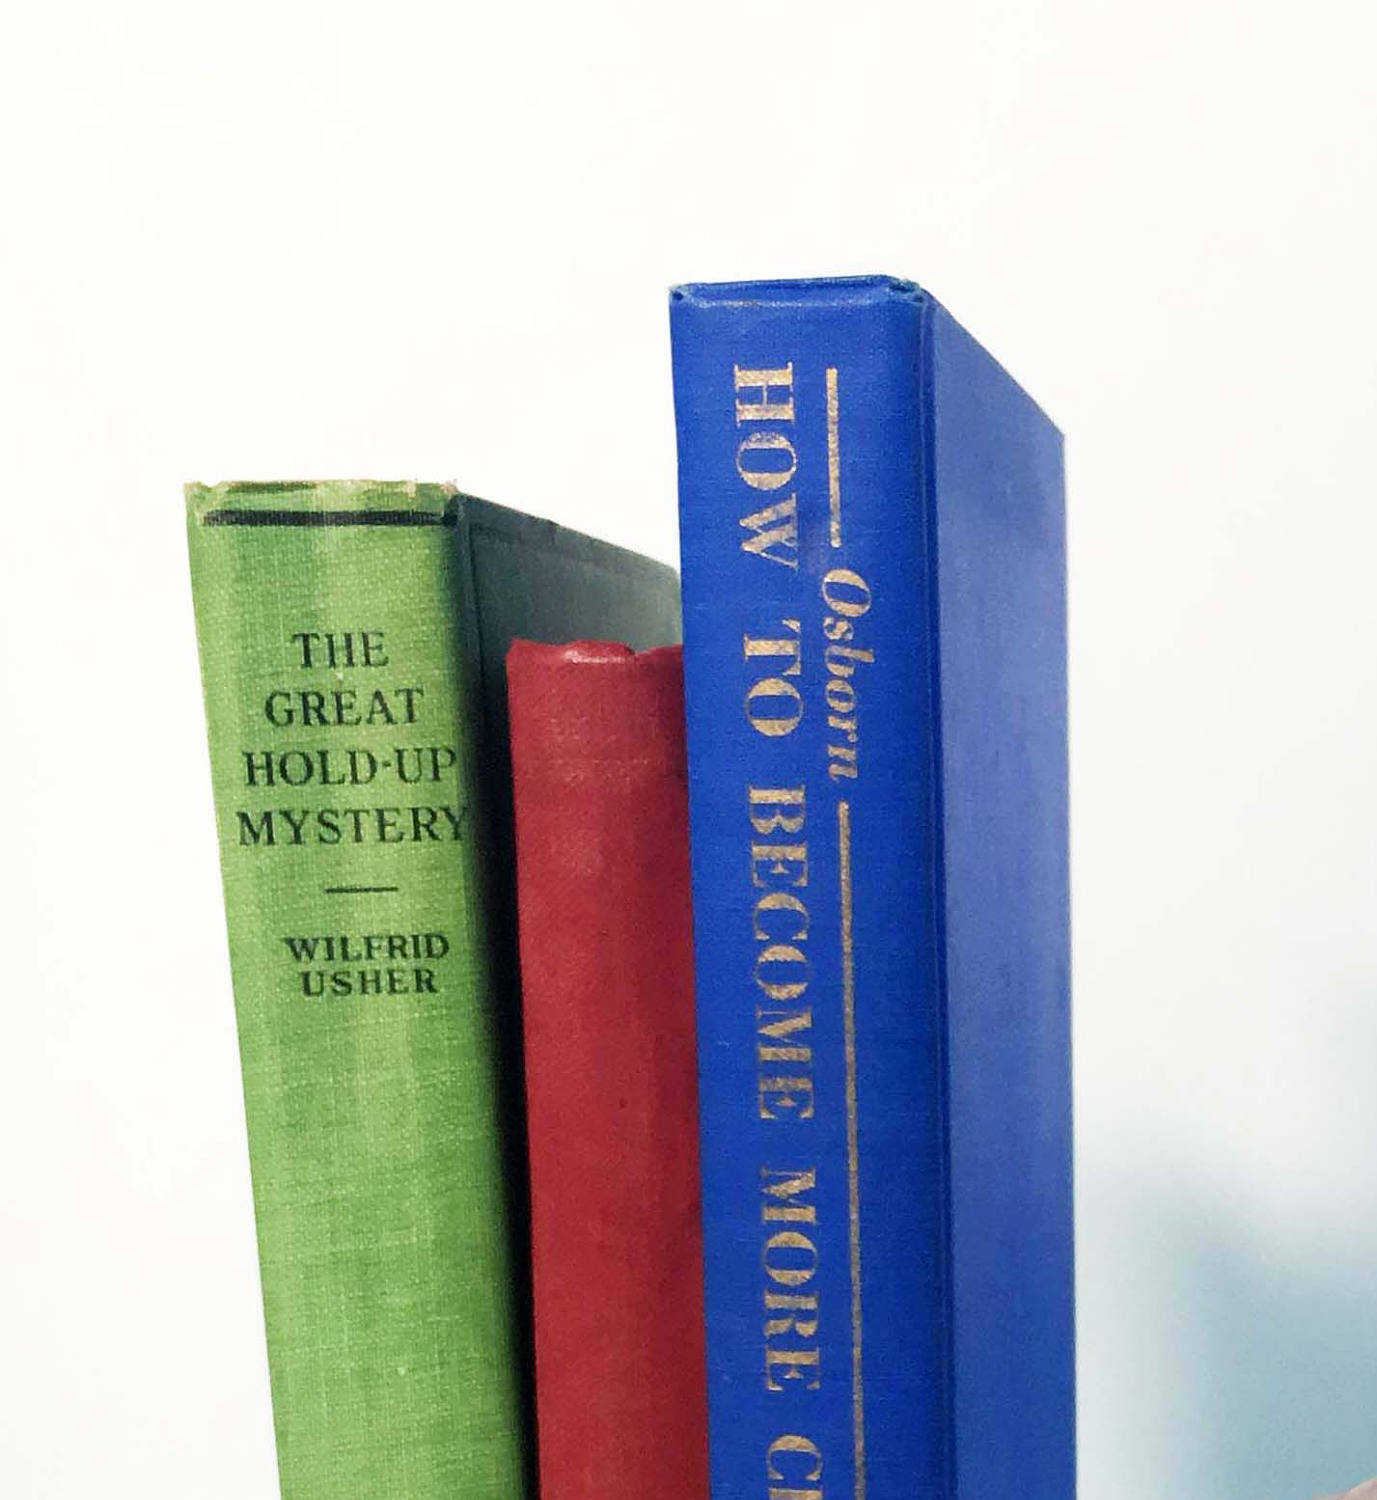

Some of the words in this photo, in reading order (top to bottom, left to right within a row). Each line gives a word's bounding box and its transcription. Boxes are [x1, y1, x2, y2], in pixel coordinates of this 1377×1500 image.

[733, 361, 799, 571] HOW
[292, 630, 390, 669] THE
[742, 617, 805, 738] TO
[821, 568, 876, 783] Osborn
[263, 687, 425, 728] GREAT
[242, 745, 458, 787] HOLD-UP
[235, 805, 469, 847] MYSTERY
[285, 932, 450, 963] WILFRID
[747, 783, 816, 1120] BECOME
[301, 967, 439, 998] USHER
[759, 1166, 822, 1392] MORE
